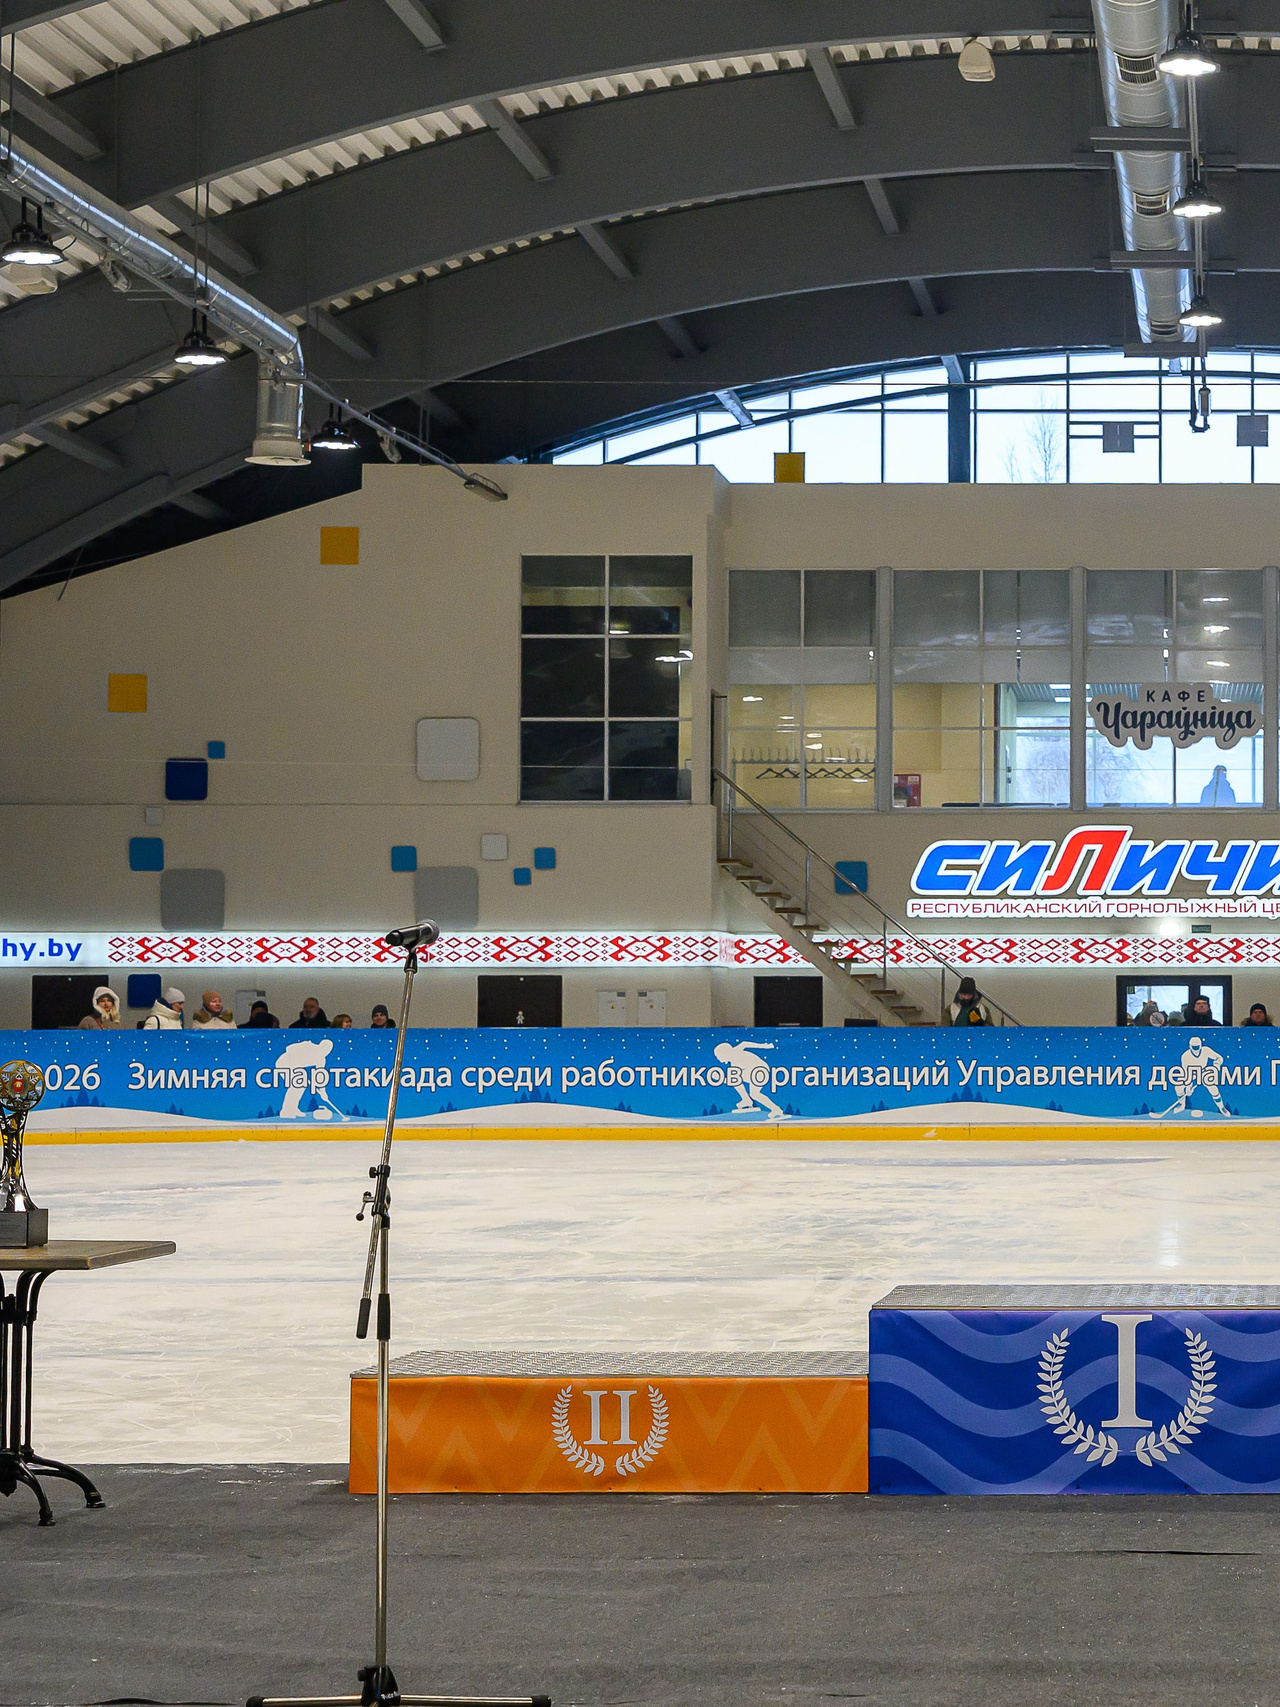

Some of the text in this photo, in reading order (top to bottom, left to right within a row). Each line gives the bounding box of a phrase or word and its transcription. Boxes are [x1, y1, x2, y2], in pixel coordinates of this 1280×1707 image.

[1146, 690, 1205, 703] КАФЕ
[911, 900, 1102, 914] РЕСПУБЛИКАНСКИЙ
[1106, 900, 1257, 914] ГОРНОЛЫЖНЫЙ
[2, 938, 83, 961] hy.by
[36, 1063, 100, 1090] 026
[128, 1062, 247, 1090] Зимняя
[255, 1067, 452, 1094] спартакиада
[460, 1067, 552, 1093] среди
[561, 1059, 743, 1093] работников
[750, 1059, 949, 1093] организаций
[958, 1059, 1140, 1093] Управления
[1148, 1065, 1262, 1091] делами
[582, 1390, 638, 1445] II
